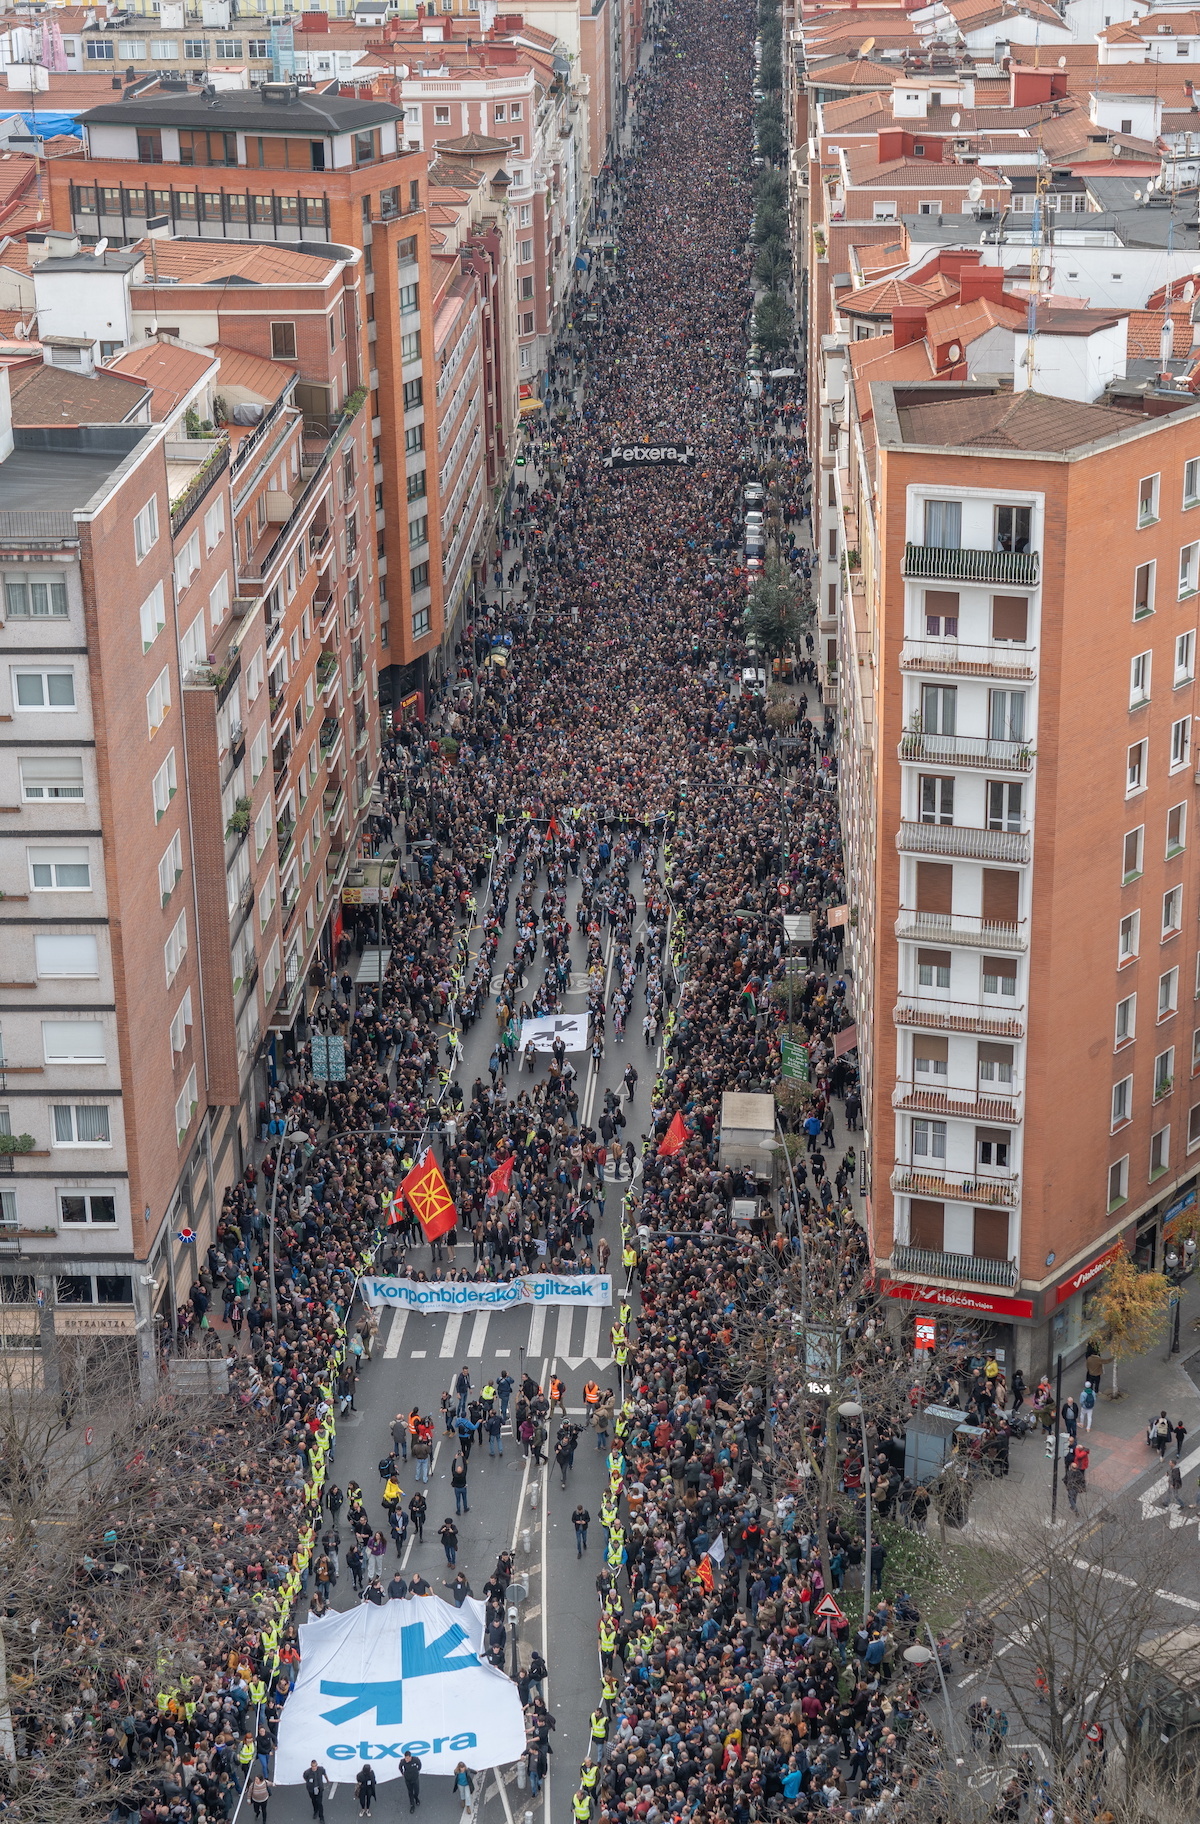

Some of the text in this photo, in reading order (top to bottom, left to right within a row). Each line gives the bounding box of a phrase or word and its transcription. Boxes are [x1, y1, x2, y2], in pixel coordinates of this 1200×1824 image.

[623, 446, 677, 461] etxera
[373, 1279, 593, 1304] Konponbiderako giltzak
[937, 1293, 994, 1310] Halcón viajes
[64, 1320, 126, 1328] ERTZAINTZA
[807, 1382, 838, 1395] 16:4
[326, 1732, 477, 1761] etxera
